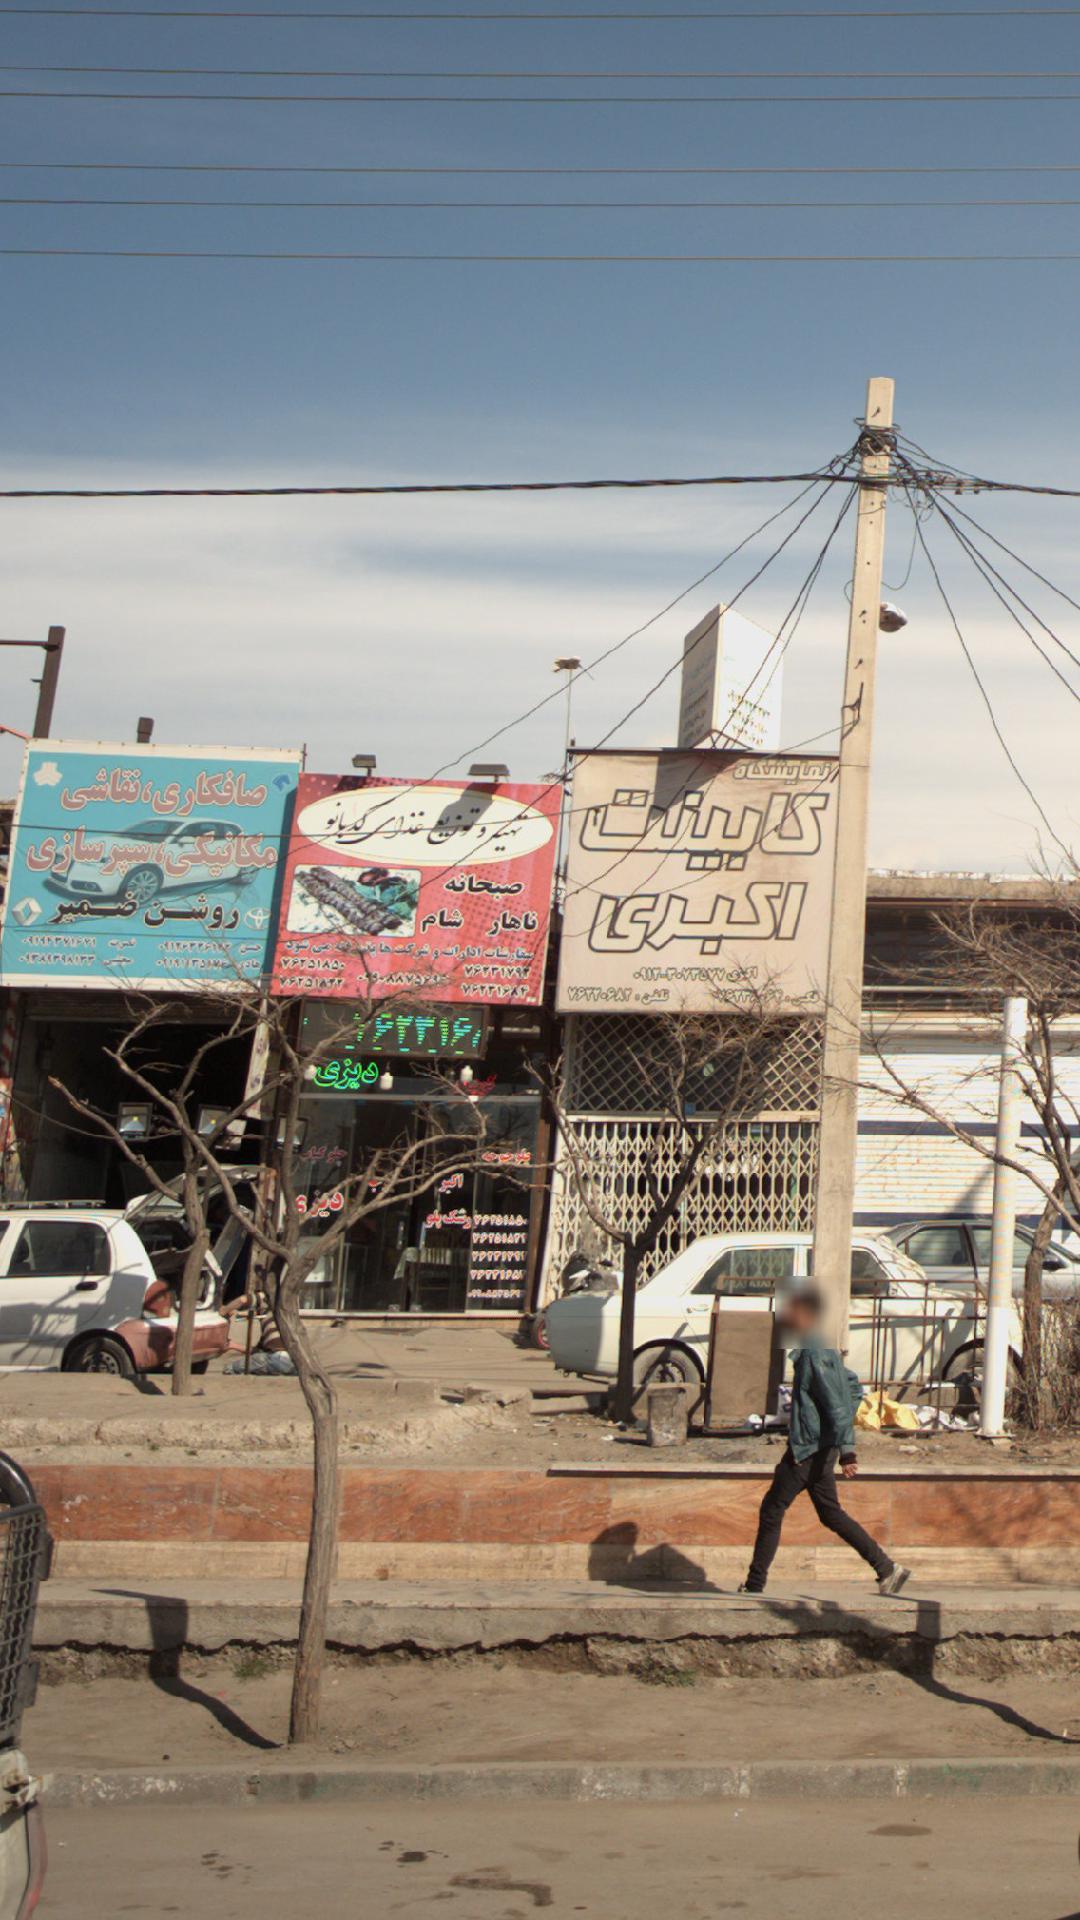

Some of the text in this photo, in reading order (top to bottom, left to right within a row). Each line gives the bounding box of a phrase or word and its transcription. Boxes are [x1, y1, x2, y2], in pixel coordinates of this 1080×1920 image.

[733, 758, 839, 785] نمایشگاه
[60, 767, 142, 810] نقاشی
[326, 802, 381, 838] کدبانو
[427, 807, 481, 844] توزیع
[476, 826, 487, 839] و
[579, 789, 830, 871] کابینت
[444, 874, 523, 898] صبحانه
[48, 891, 241, 930] روشن ضمیر
[421, 908, 538, 934] ناهار شام
[588, 882, 808, 956] اکبری
[286, 937, 310, 952] شود
[311, 941, 331, 953] می
[379, 941, 392, 953] ها
[394, 942, 430, 958] شرکت
[442, 947, 482, 962] ادارات
[313, 1058, 379, 1090] دیزی
